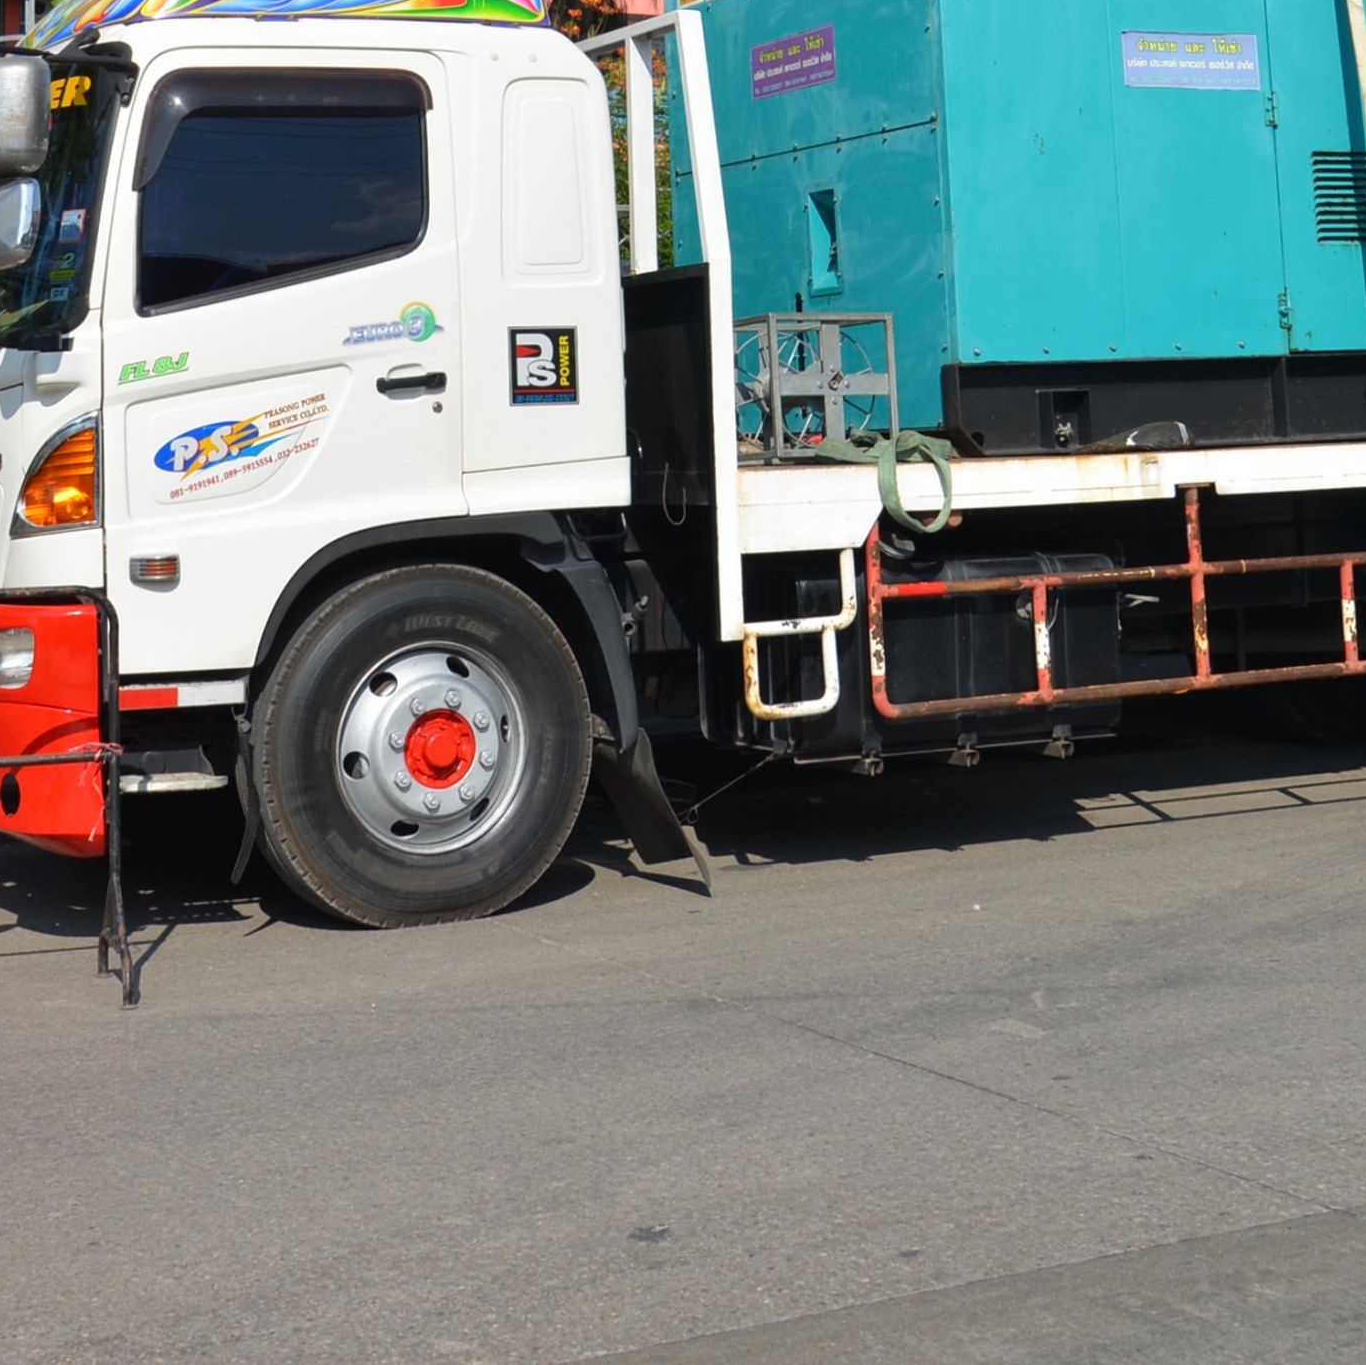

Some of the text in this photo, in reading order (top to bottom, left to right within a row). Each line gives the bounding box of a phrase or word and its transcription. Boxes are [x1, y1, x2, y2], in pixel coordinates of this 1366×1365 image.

[348, 321, 404, 345] EURO
[559, 335, 570, 386] POWER
[301, 393, 326, 408] POWER
[268, 412, 299, 430] SERVICE
